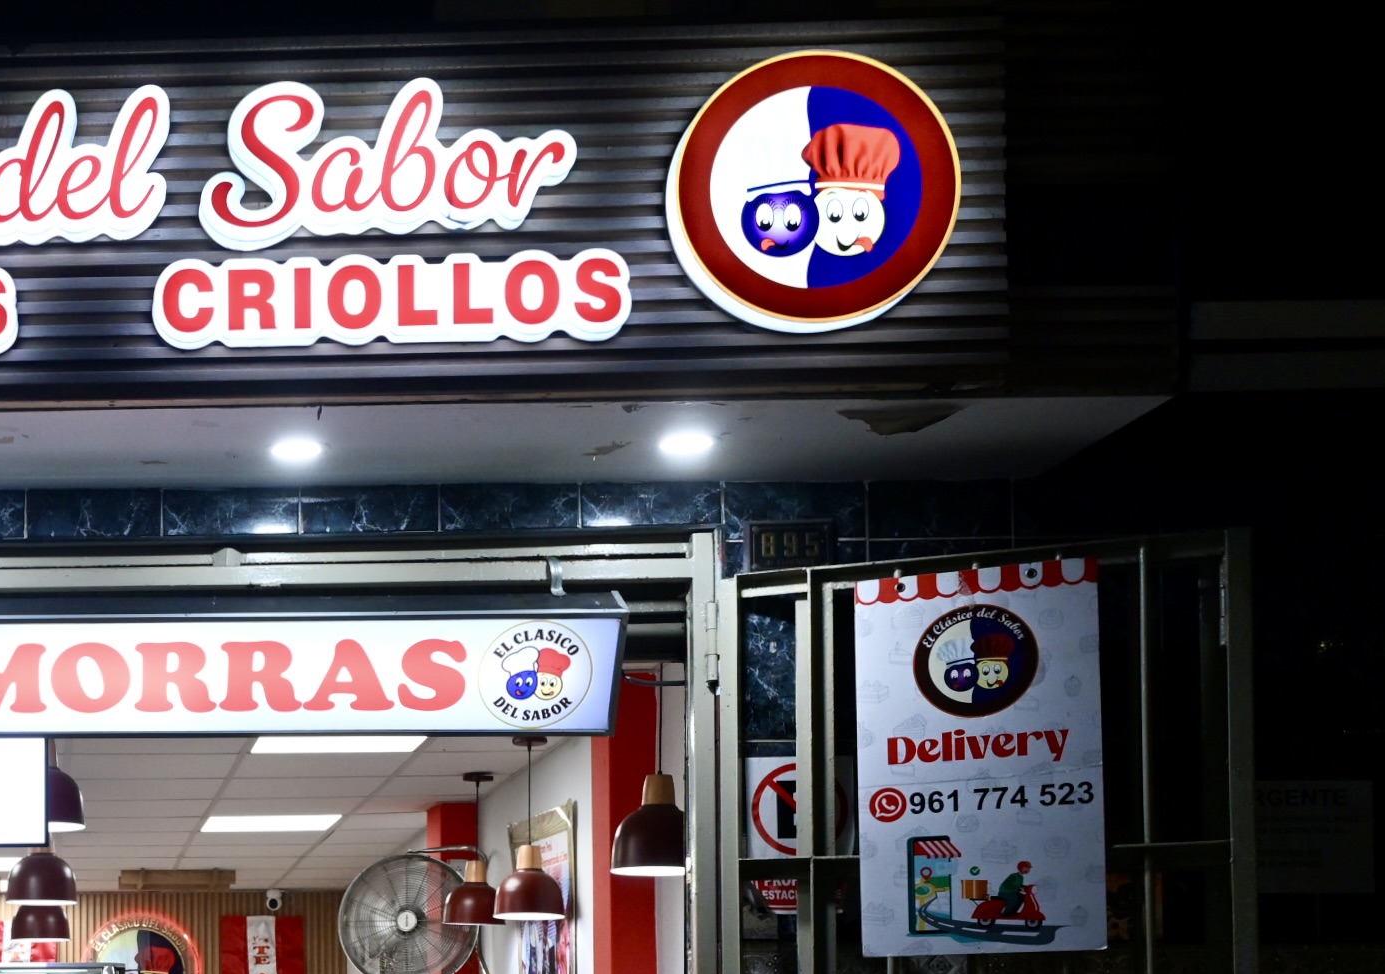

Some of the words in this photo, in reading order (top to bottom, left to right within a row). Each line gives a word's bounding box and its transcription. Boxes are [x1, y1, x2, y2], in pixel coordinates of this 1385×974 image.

[213, 90, 564, 228] Sabor
[161, 258, 622, 333] CRIOLLOS
[761, 531, 821, 558] 895
[493, 641, 514, 659] EL
[513, 628, 580, 656] CLASICO
[922, 633, 936, 649] El
[933, 610, 974, 635] Clásico
[976, 606, 999, 620] del
[998, 612, 1026, 641] Sabor
[493, 696, 519, 719] DEL
[522, 696, 573, 721] SABOR
[886, 728, 1069, 765] Delivery
[909, 789, 961, 815] 961
[973, 786, 1028, 812] 774
[1040, 781, 1094, 806] 523
[1255, 788, 1348, 806] RGENTE
[253, 945, 271, 965] TE
